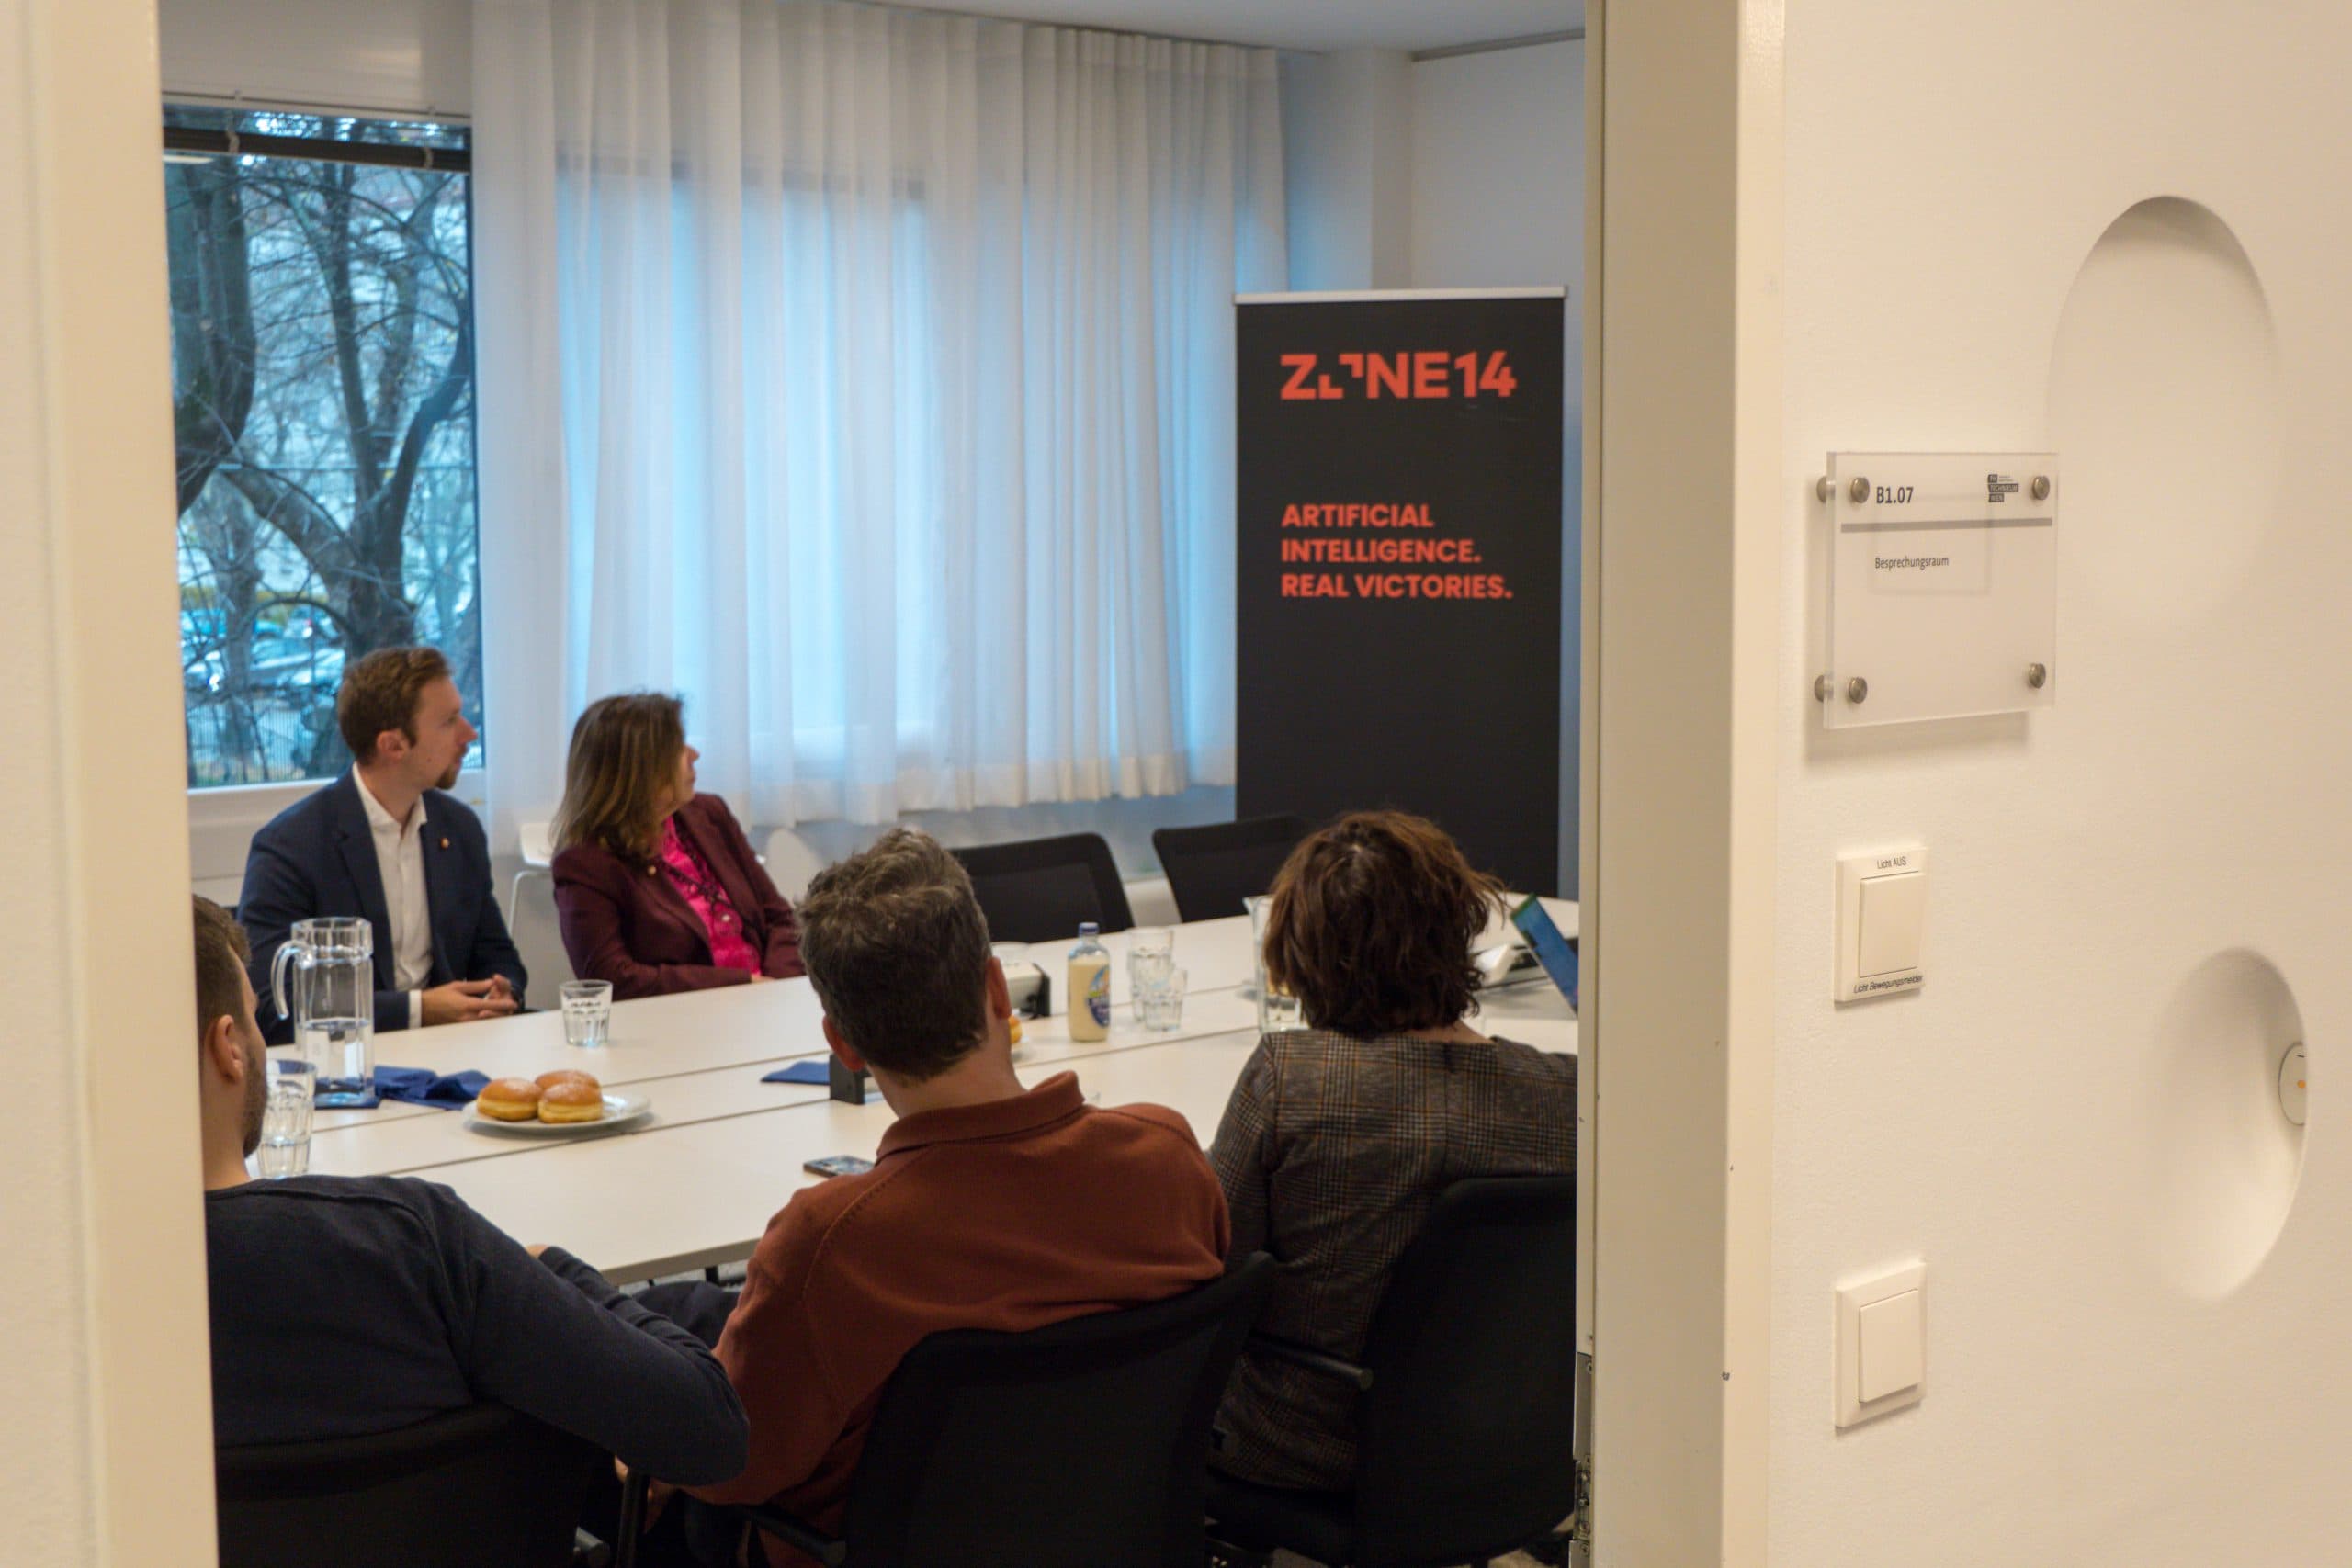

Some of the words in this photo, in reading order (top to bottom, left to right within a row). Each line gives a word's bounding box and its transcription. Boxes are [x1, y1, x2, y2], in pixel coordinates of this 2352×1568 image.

[1876, 486, 1914, 504] B1.07
[1282, 503, 1435, 528] ARTIFICIAL
[1282, 538, 1482, 563] INTELLIGENCE.
[1875, 556, 1949, 570] Besprechungsraum
[1282, 574, 1350, 598] REAL
[1355, 574, 1513, 599] VICTORIES.
[1877, 858, 1892, 869] Licht
[1893, 856, 1906, 866] AUS
[1854, 984, 1870, 994] Licht
[1870, 976, 1923, 990] Bewegungsmelder
